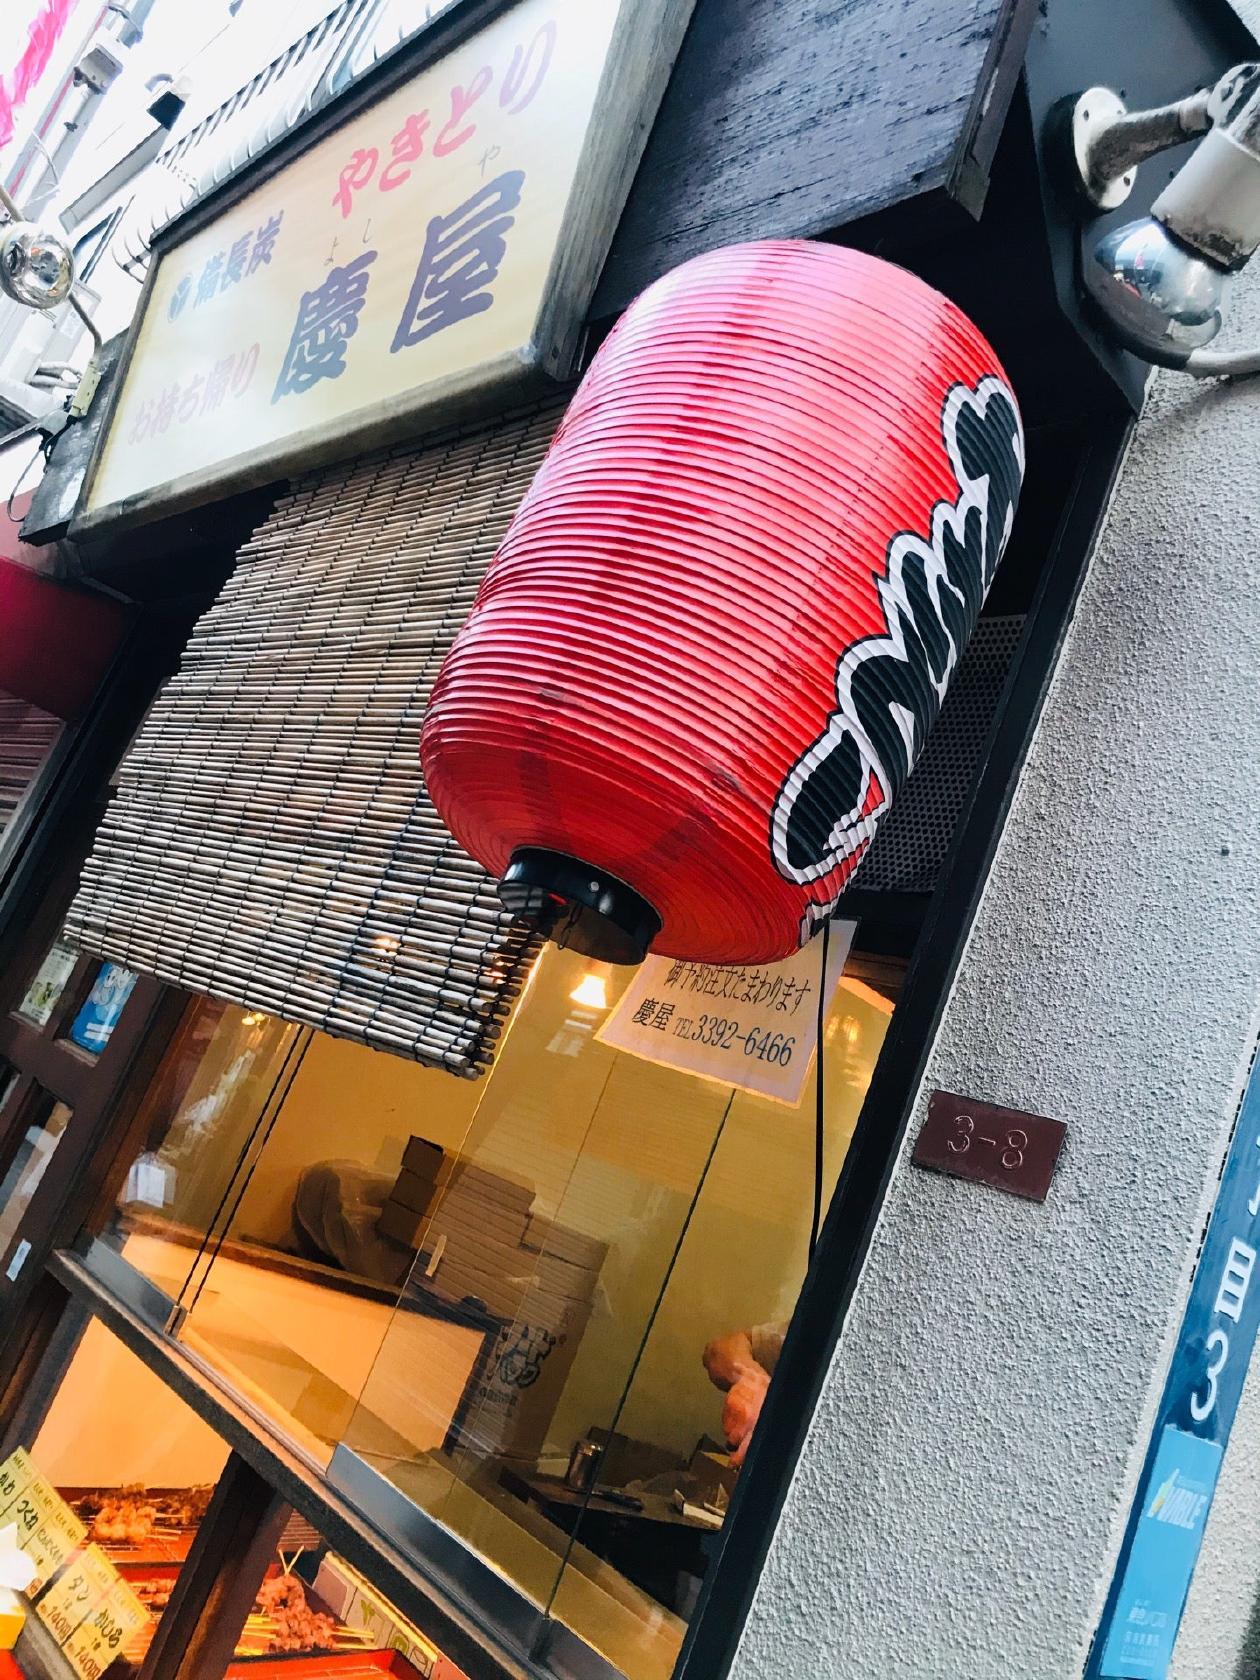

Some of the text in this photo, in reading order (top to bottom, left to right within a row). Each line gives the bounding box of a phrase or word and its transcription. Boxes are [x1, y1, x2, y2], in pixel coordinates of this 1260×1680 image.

[332, 20, 557, 219] やきとり
[128, 342, 260, 445] お持ち帰り
[631, 997, 677, 1032] 慶屋
[690, 1013, 796, 1068] 3392-6466
[946, 1114, 1029, 1171] 3-8
[1190, 1331, 1229, 1422] 3
